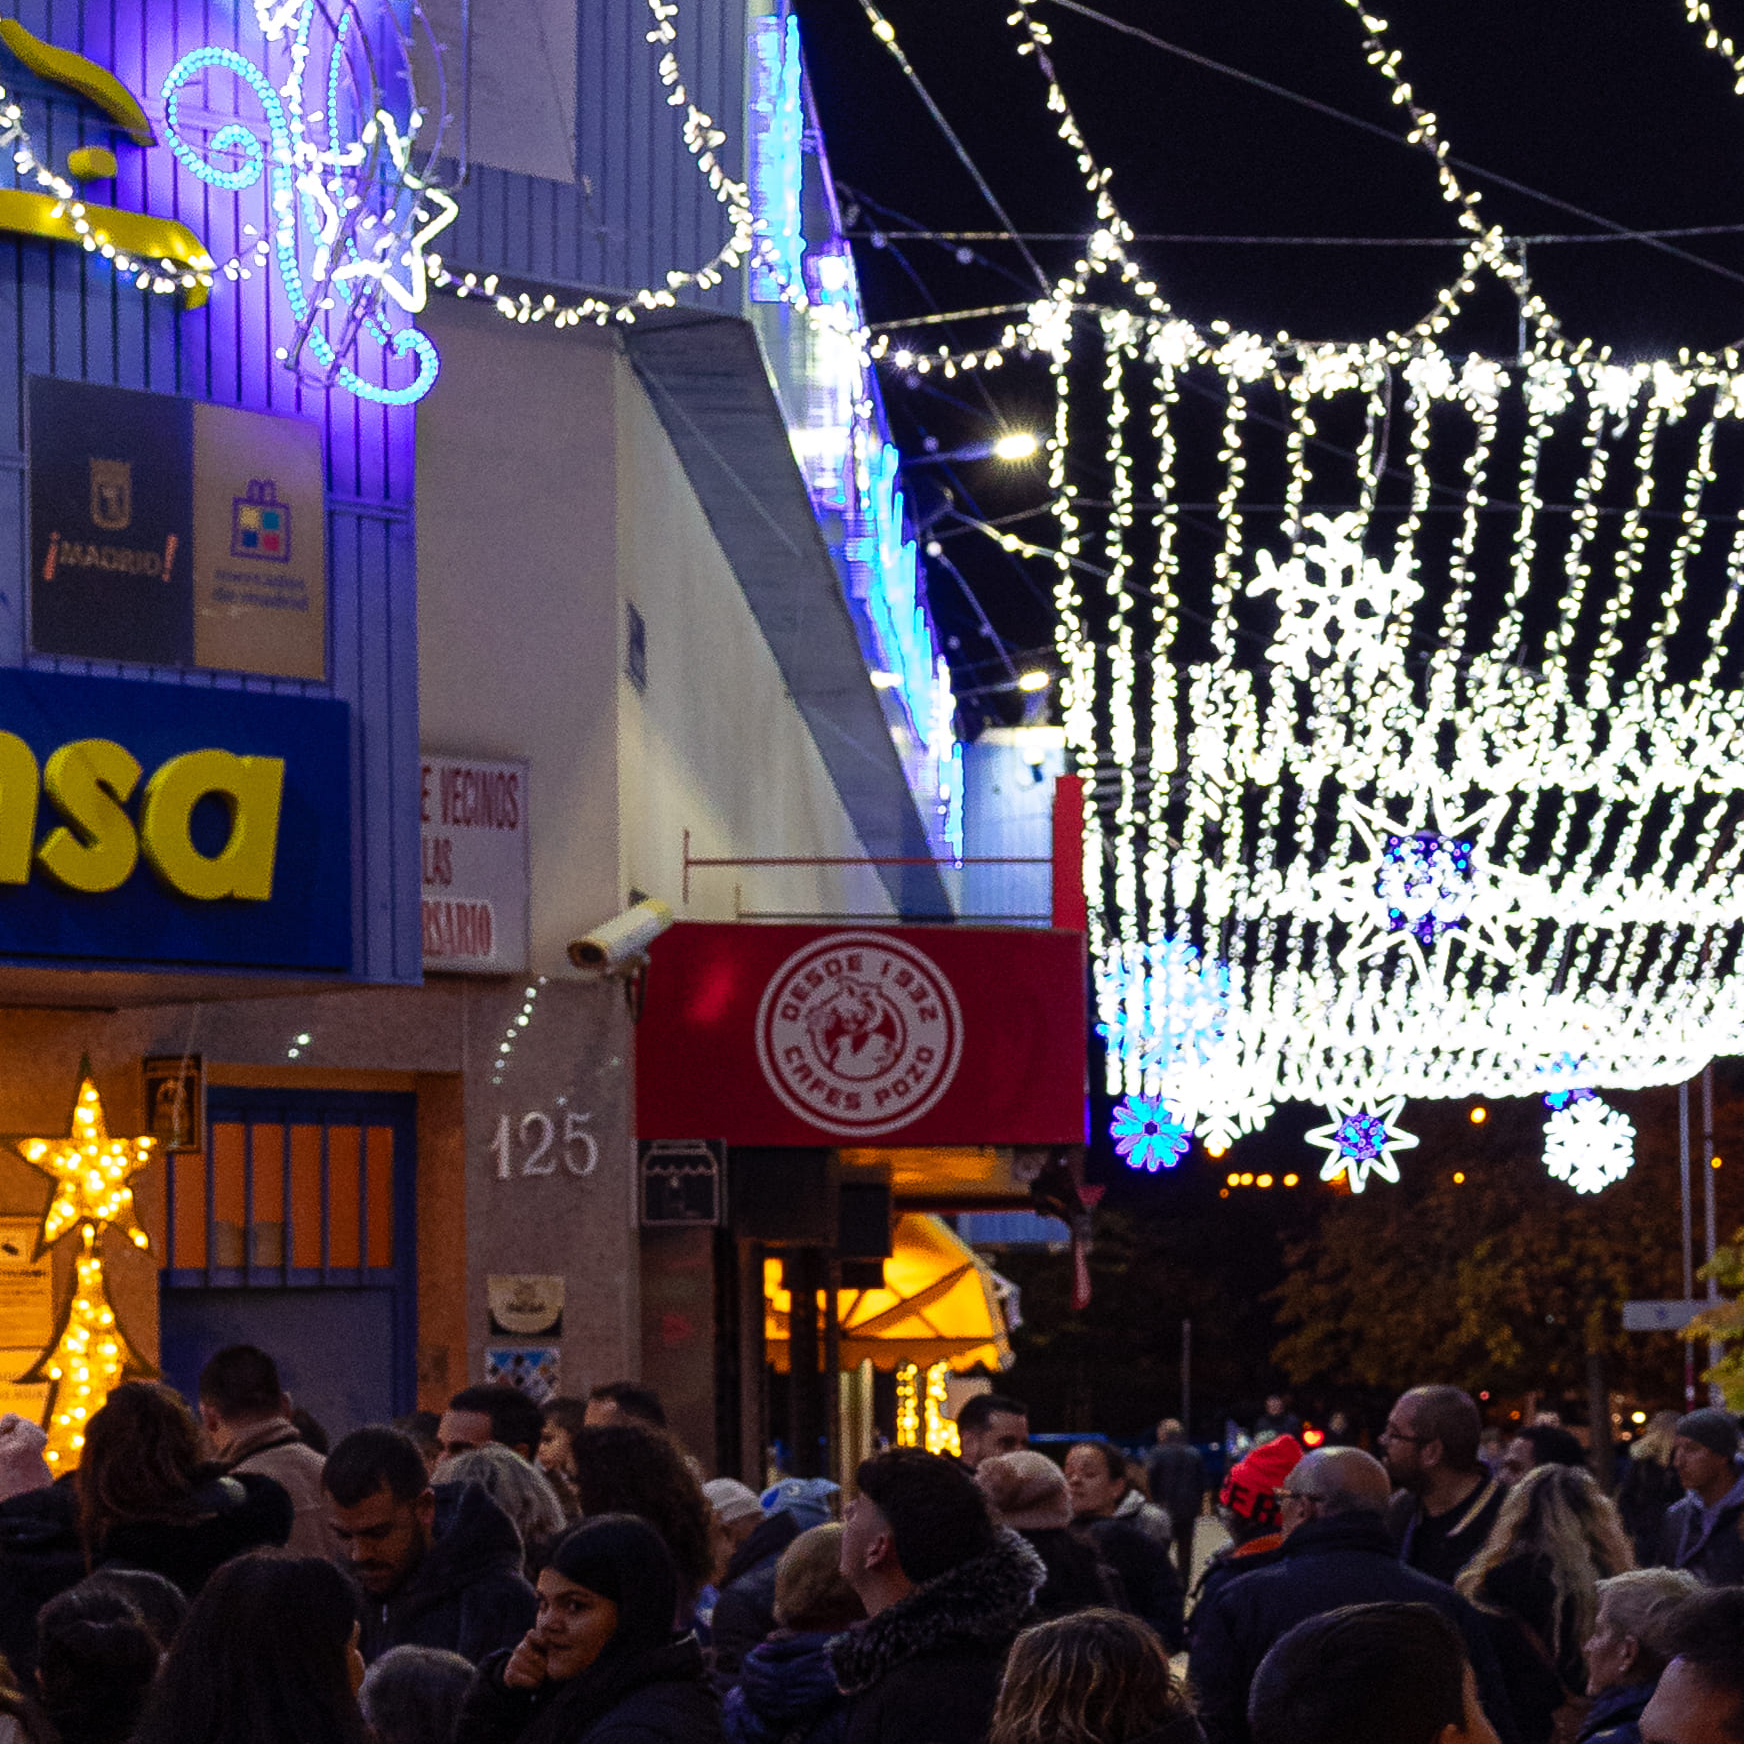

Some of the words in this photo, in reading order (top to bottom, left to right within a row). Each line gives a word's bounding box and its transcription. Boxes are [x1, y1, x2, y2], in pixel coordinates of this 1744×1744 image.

[440, 767, 519, 830] VECINOS
[781, 954, 863, 1021] DESDE
[874, 1046, 934, 1107] POZO
[489, 1110, 600, 1180] 125
